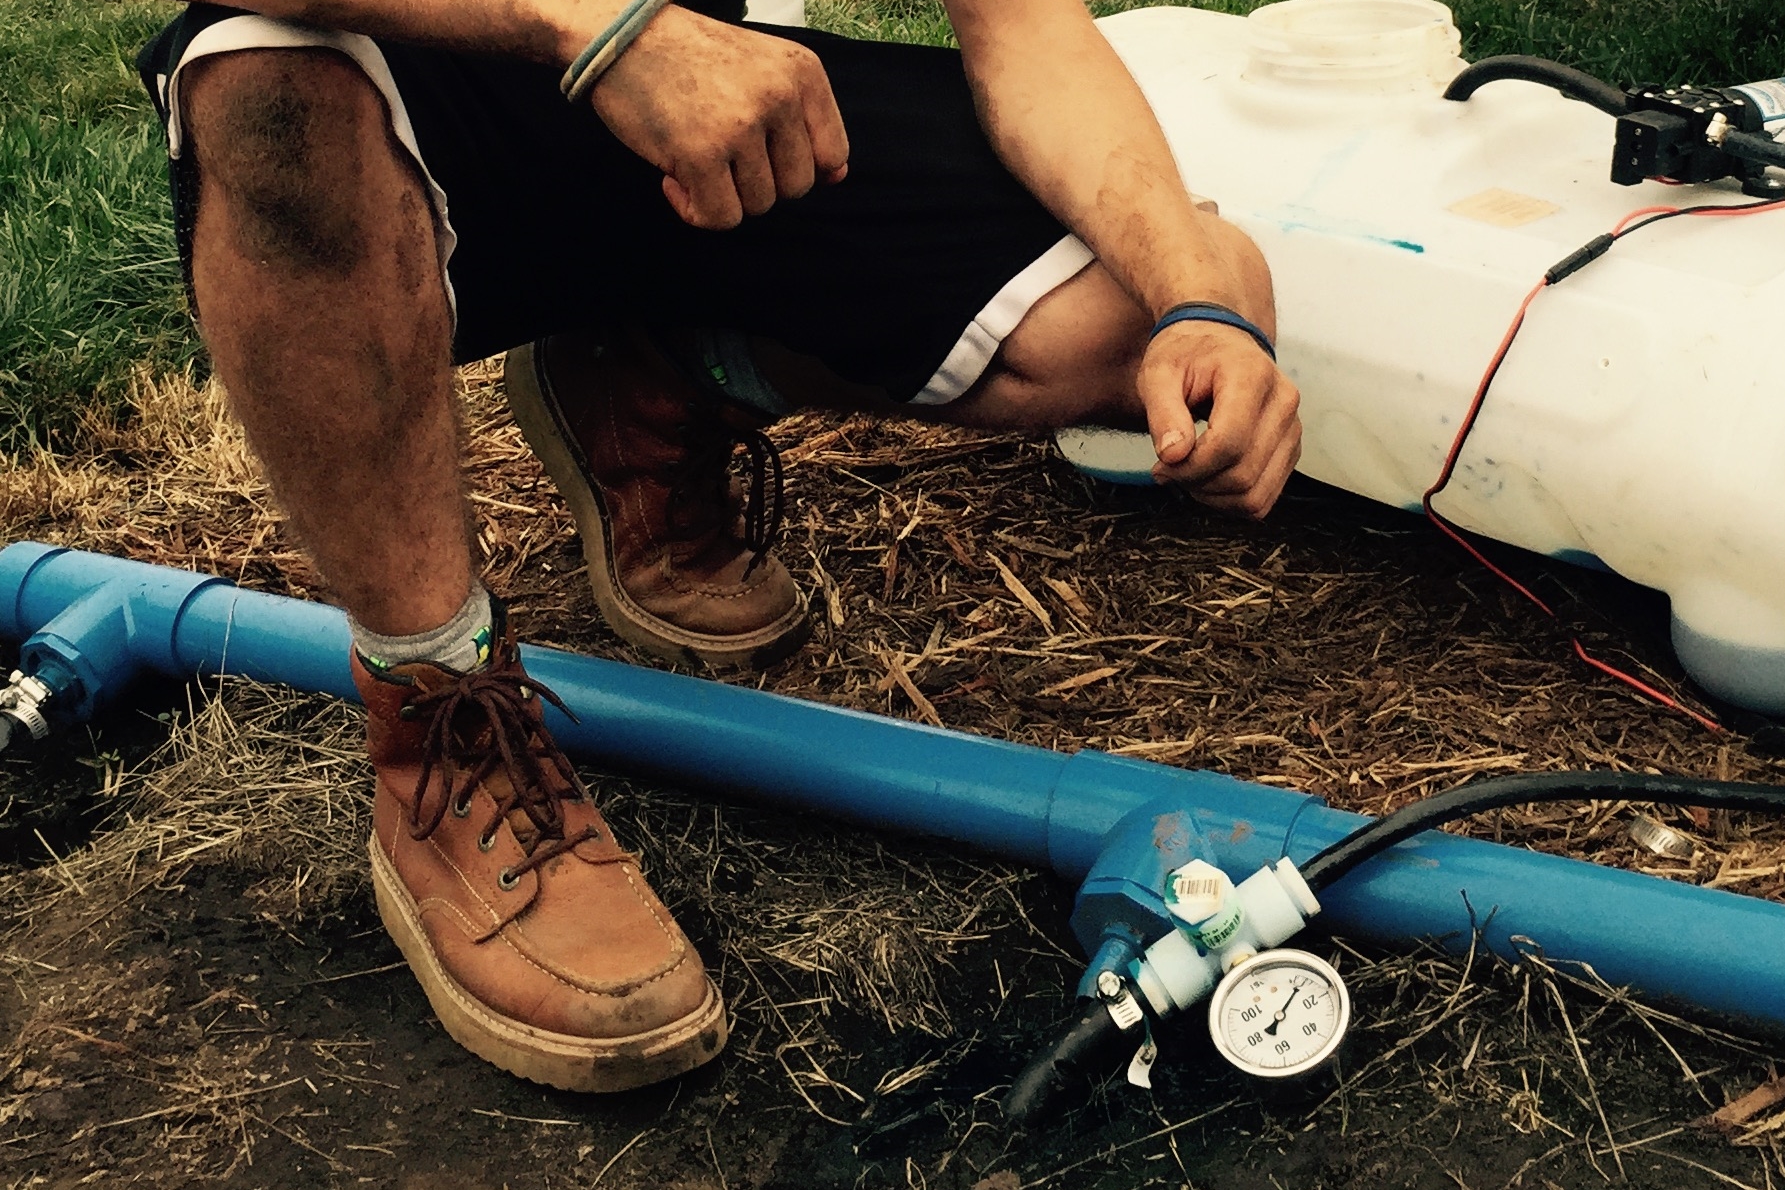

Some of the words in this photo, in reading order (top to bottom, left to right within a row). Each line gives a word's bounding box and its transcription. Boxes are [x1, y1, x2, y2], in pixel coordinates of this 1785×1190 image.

[1302, 994, 1319, 1010] 20
[1240, 1004, 1263, 1023] 100
[1301, 1022, 1317, 1036] 40
[1247, 1031, 1264, 1047] 80
[1274, 1040, 1291, 1055] 60
